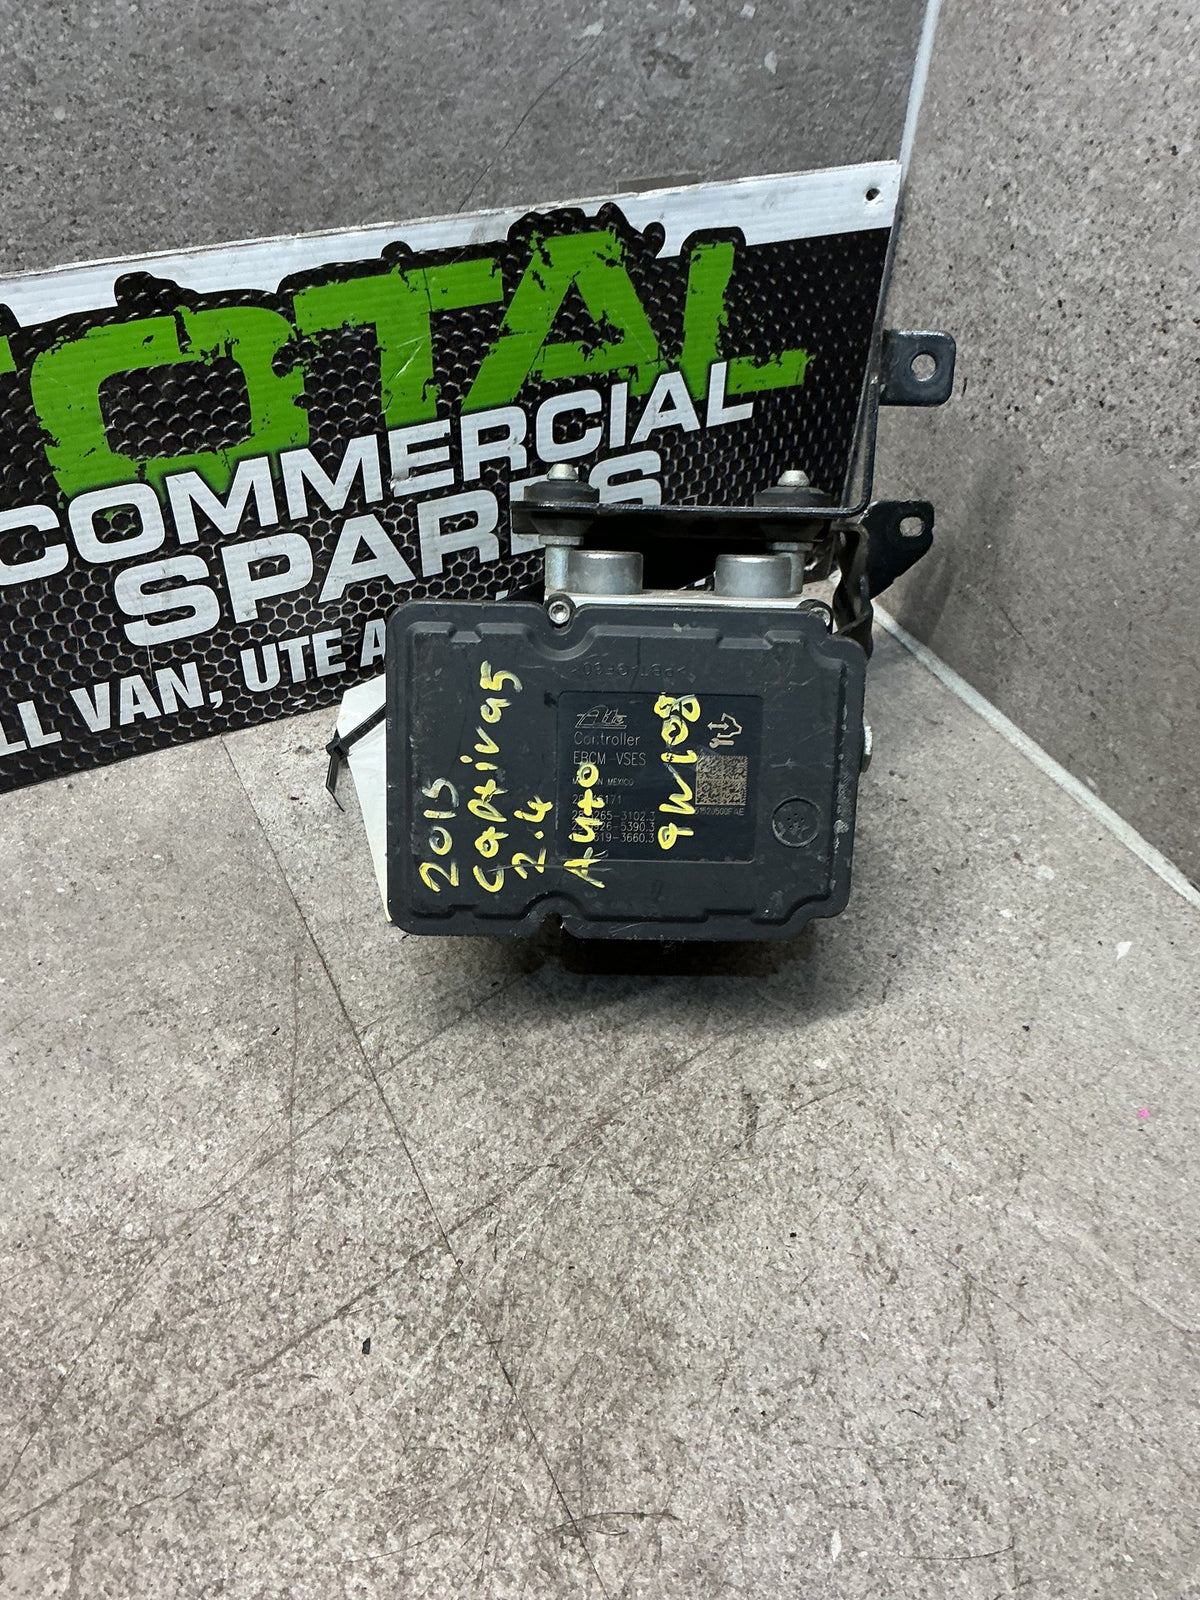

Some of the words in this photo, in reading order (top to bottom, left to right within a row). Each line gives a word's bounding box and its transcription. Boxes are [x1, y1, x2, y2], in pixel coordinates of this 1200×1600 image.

[0, 228, 815, 498] OTAL
[0, 362, 754, 586] COMMERCIAL
[70, 662, 223, 734] VAN,
[240, 628, 348, 693] UTE
[573, 731, 641, 746] Controller
[418, 777, 460, 893] 2015
[511, 794, 553, 881] 2.4
